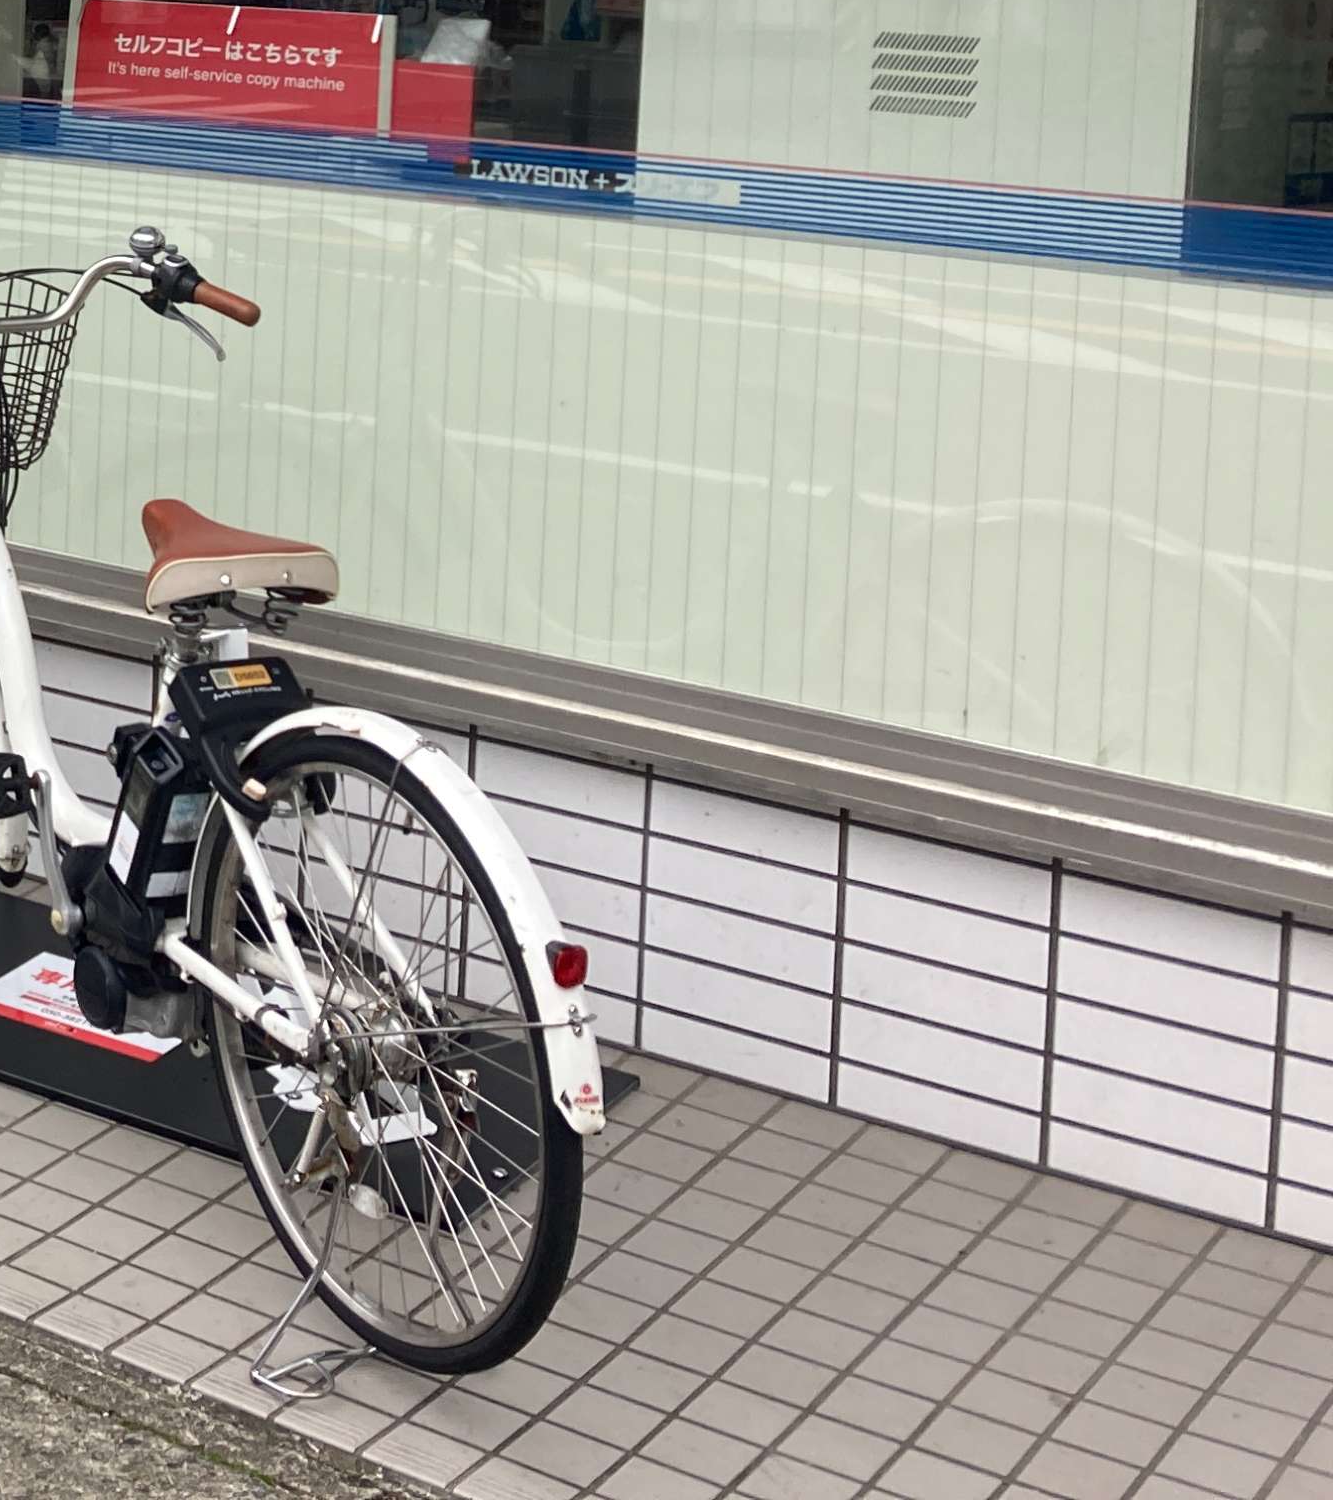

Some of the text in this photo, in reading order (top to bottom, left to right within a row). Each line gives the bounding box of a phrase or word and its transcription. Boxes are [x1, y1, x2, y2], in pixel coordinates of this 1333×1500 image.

[114, 32, 343, 68] セルフコピーはこちらです
[107, 61, 345, 92] It's here self-service copy machine
[469, 158, 589, 191] LAWSON
